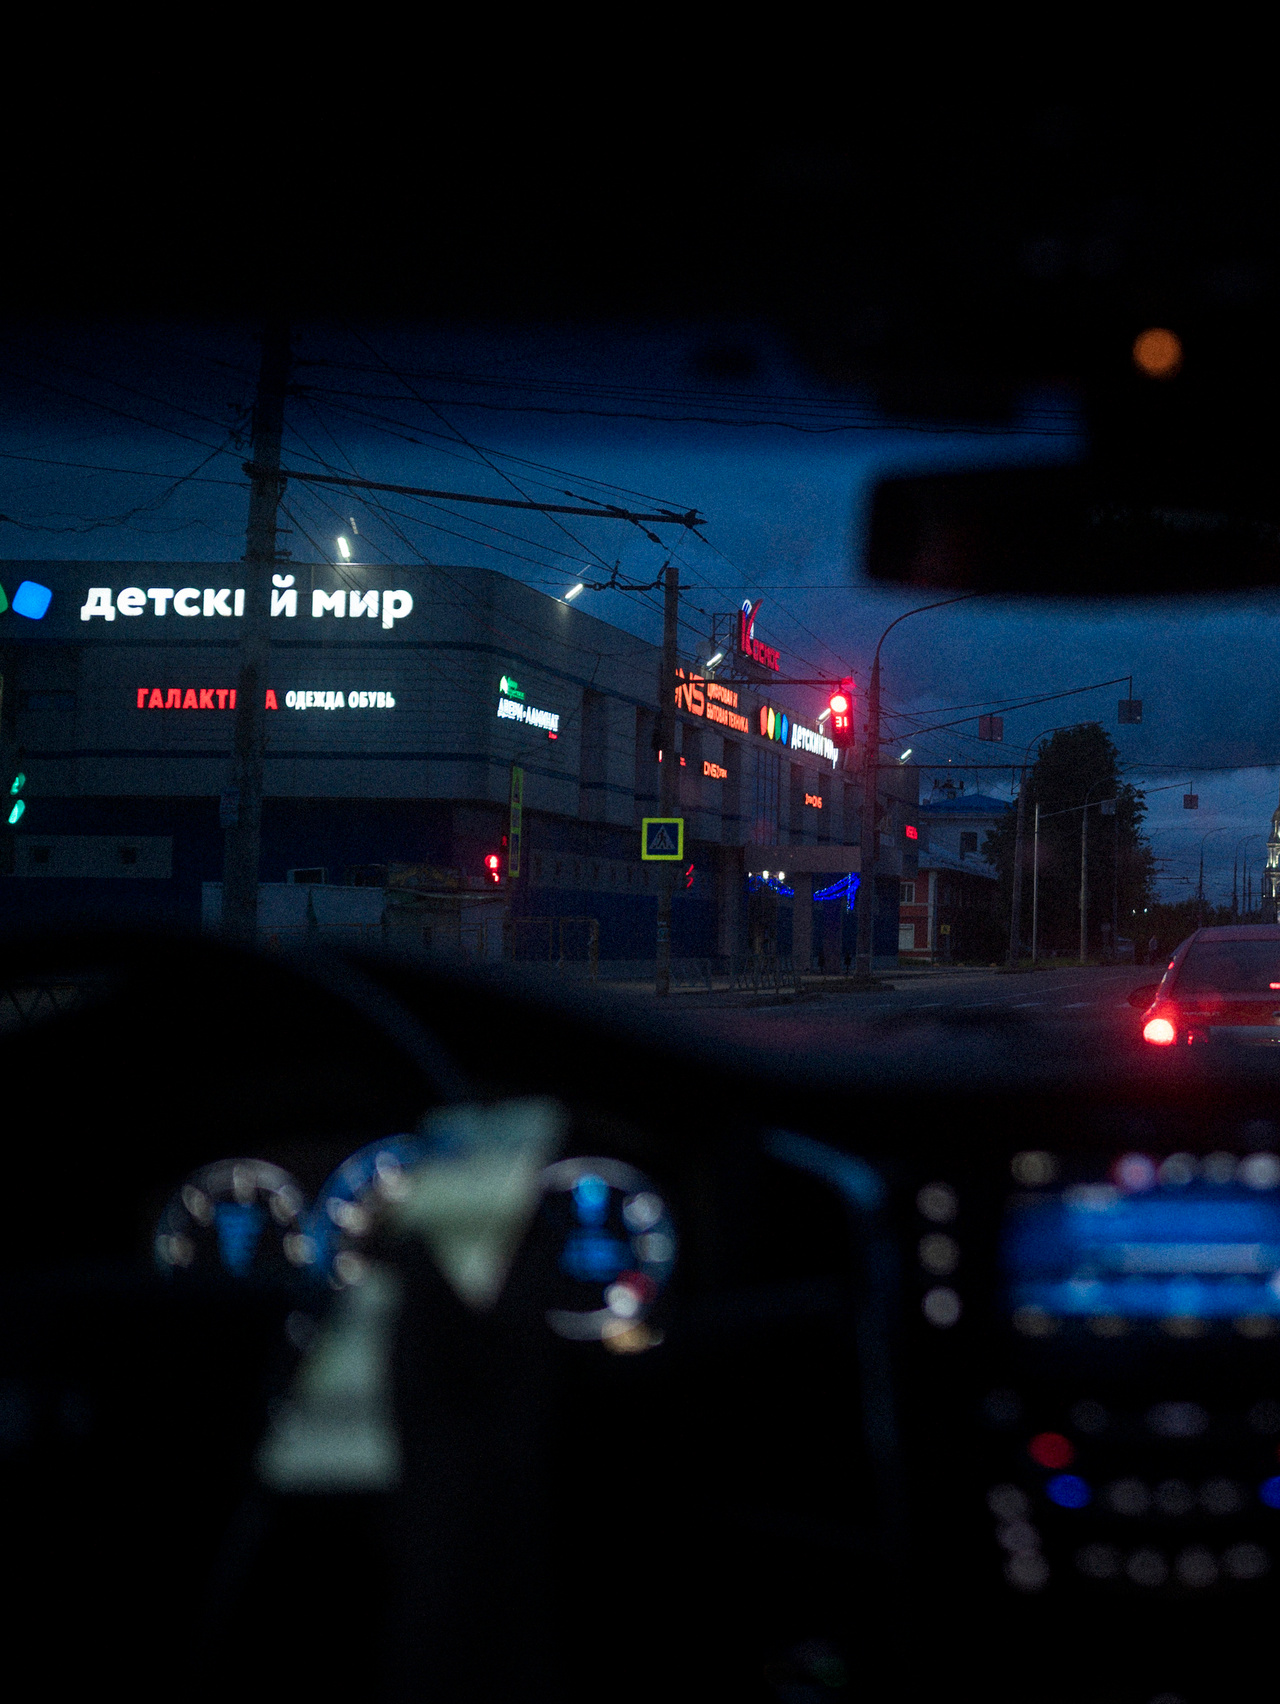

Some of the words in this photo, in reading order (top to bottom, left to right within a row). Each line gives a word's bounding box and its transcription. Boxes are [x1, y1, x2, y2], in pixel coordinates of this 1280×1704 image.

[311, 588, 414, 629] мир
[136, 688, 278, 710] ГАЛАКТА
[285, 690, 345, 710] ОДЕЖДА
[348, 690, 396, 709] ОБУВЬ
[728, 710, 749, 733] ТЕХНИКА
[835, 716, 848, 728] 31
